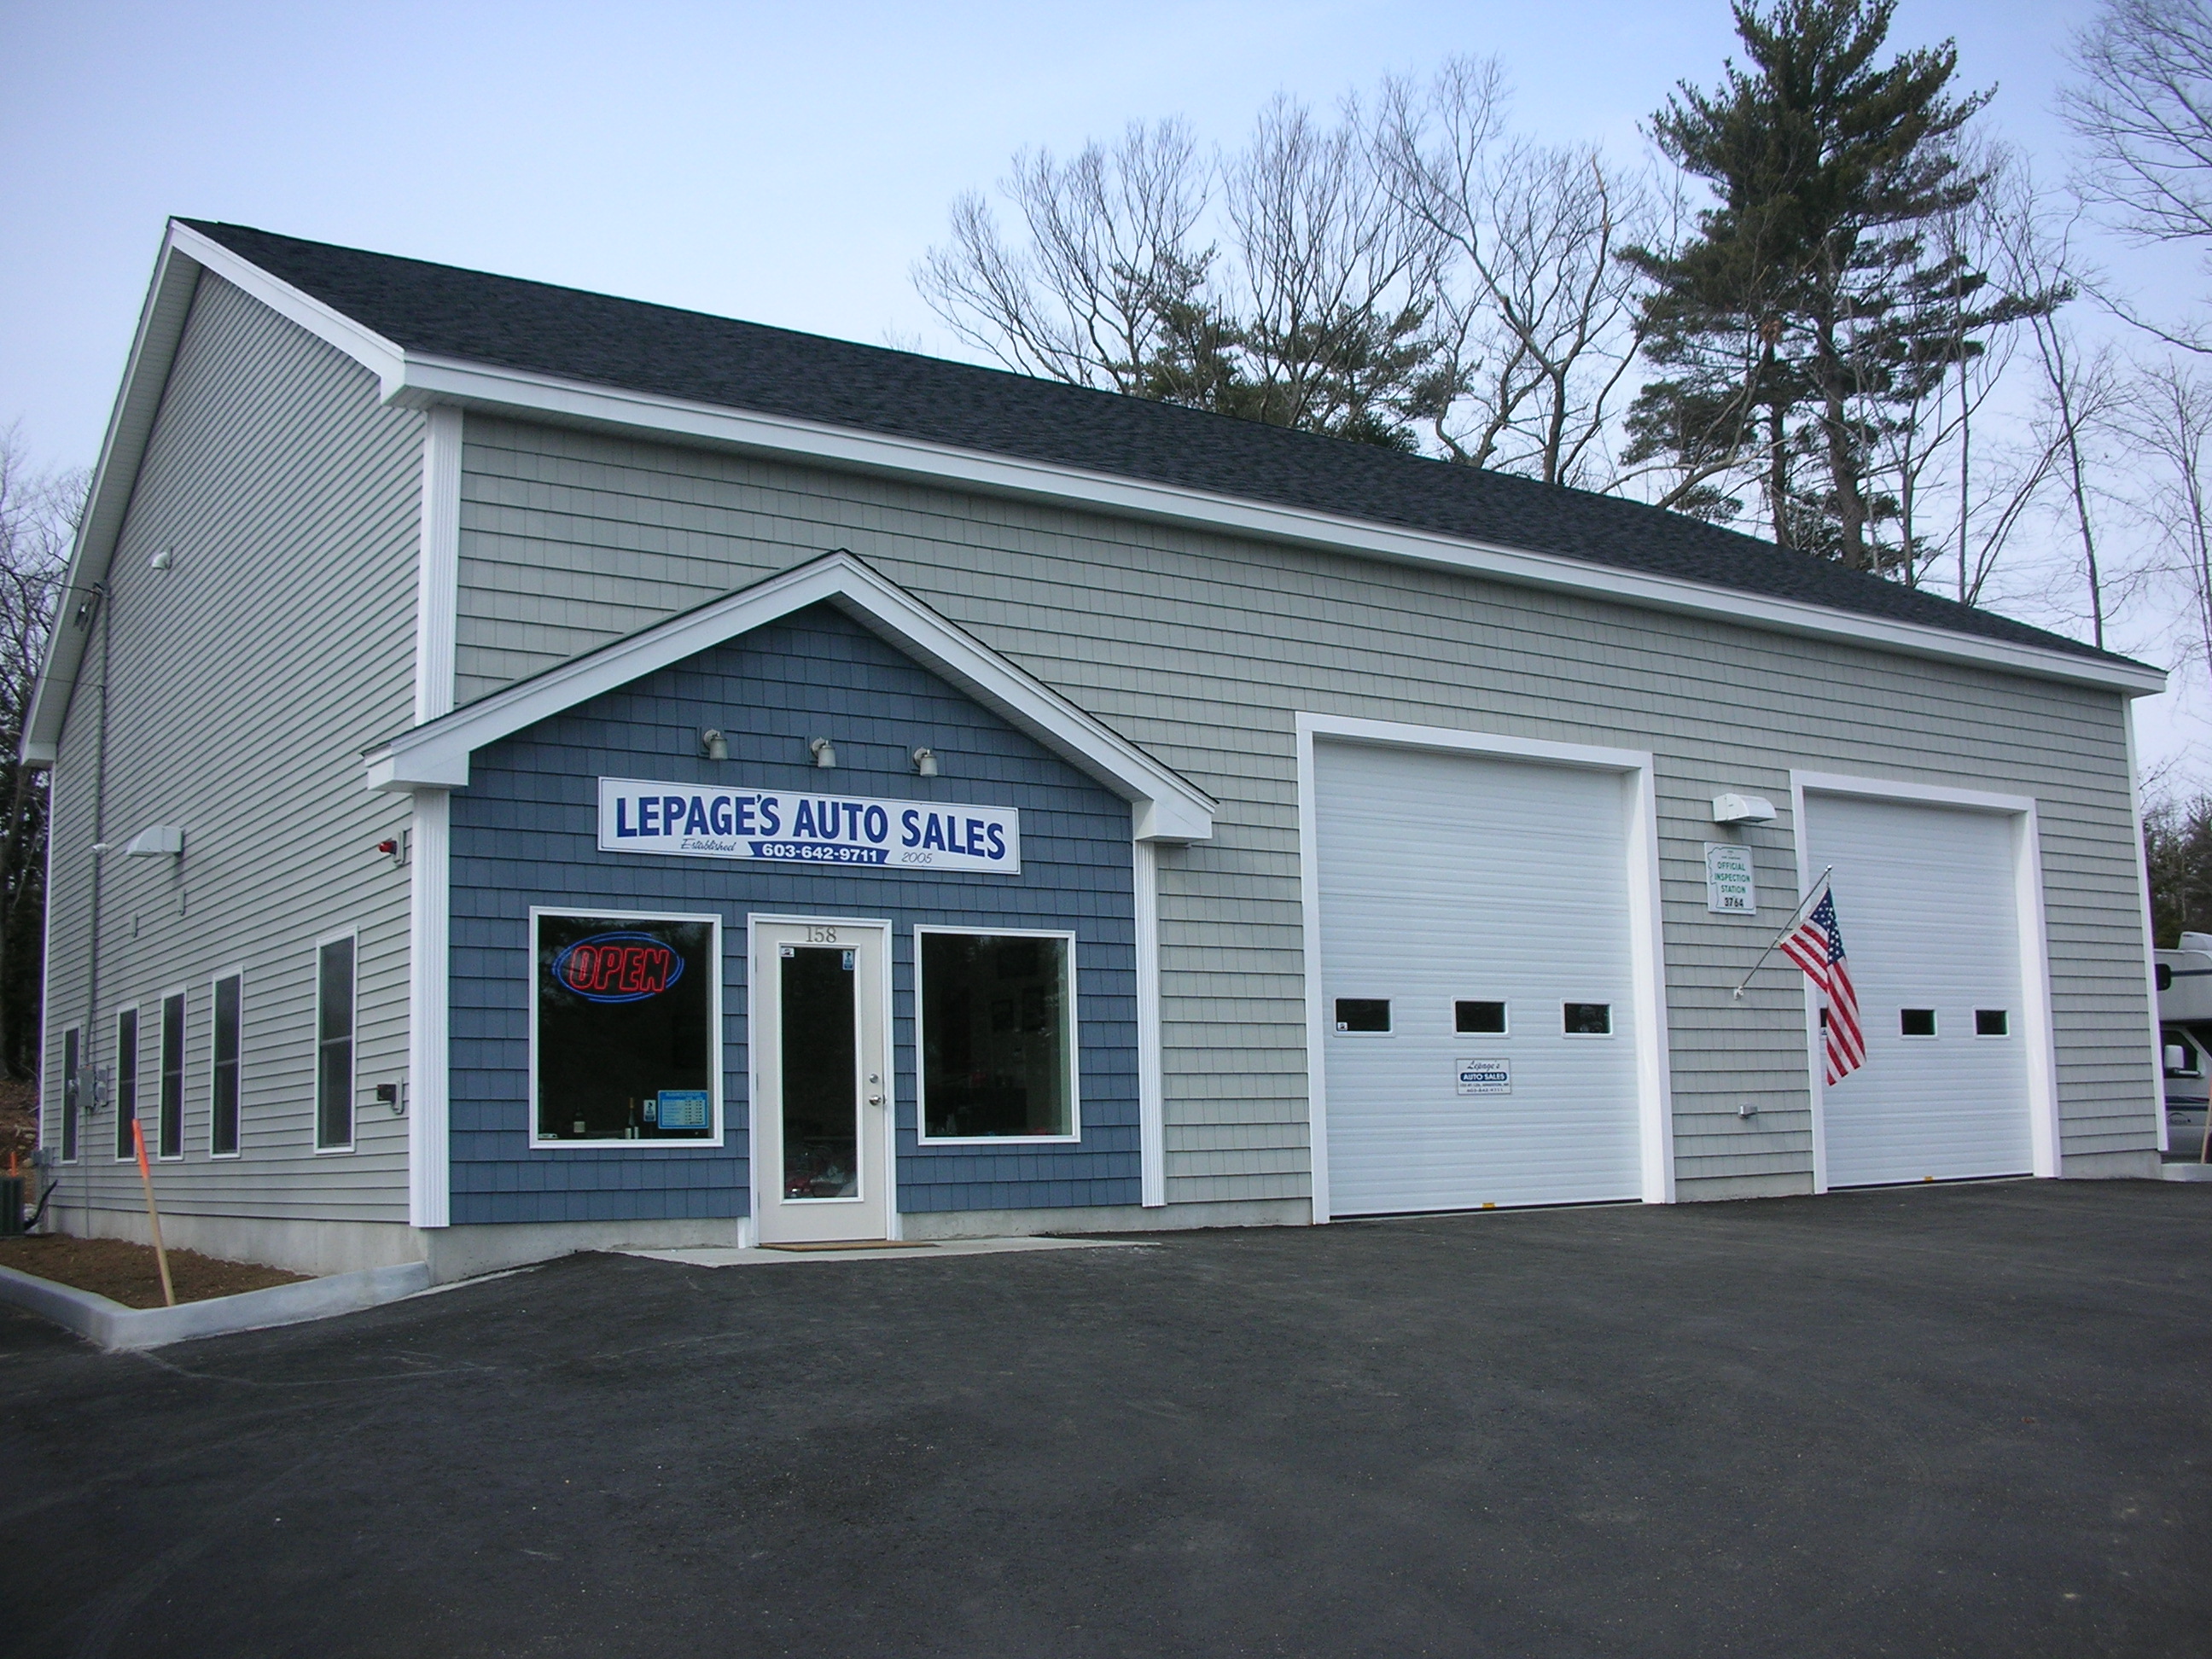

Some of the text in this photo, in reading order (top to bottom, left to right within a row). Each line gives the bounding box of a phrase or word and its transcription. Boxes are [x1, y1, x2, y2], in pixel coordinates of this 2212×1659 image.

[616, 794, 1006, 860] LEPAGE'S AUTO SALES
[681, 838, 736, 852] Established
[762, 843, 877, 863] 603-642-9711
[901, 852, 933, 864] 2005
[1717, 861, 1746, 871] OFFICIAL
[1714, 873, 1750, 882] INSPECTION
[1721, 884, 1746, 894] STATION
[1725, 897, 1743, 907] 3764
[806, 926, 837, 943] 158
[569, 946, 670, 992] OPEN
